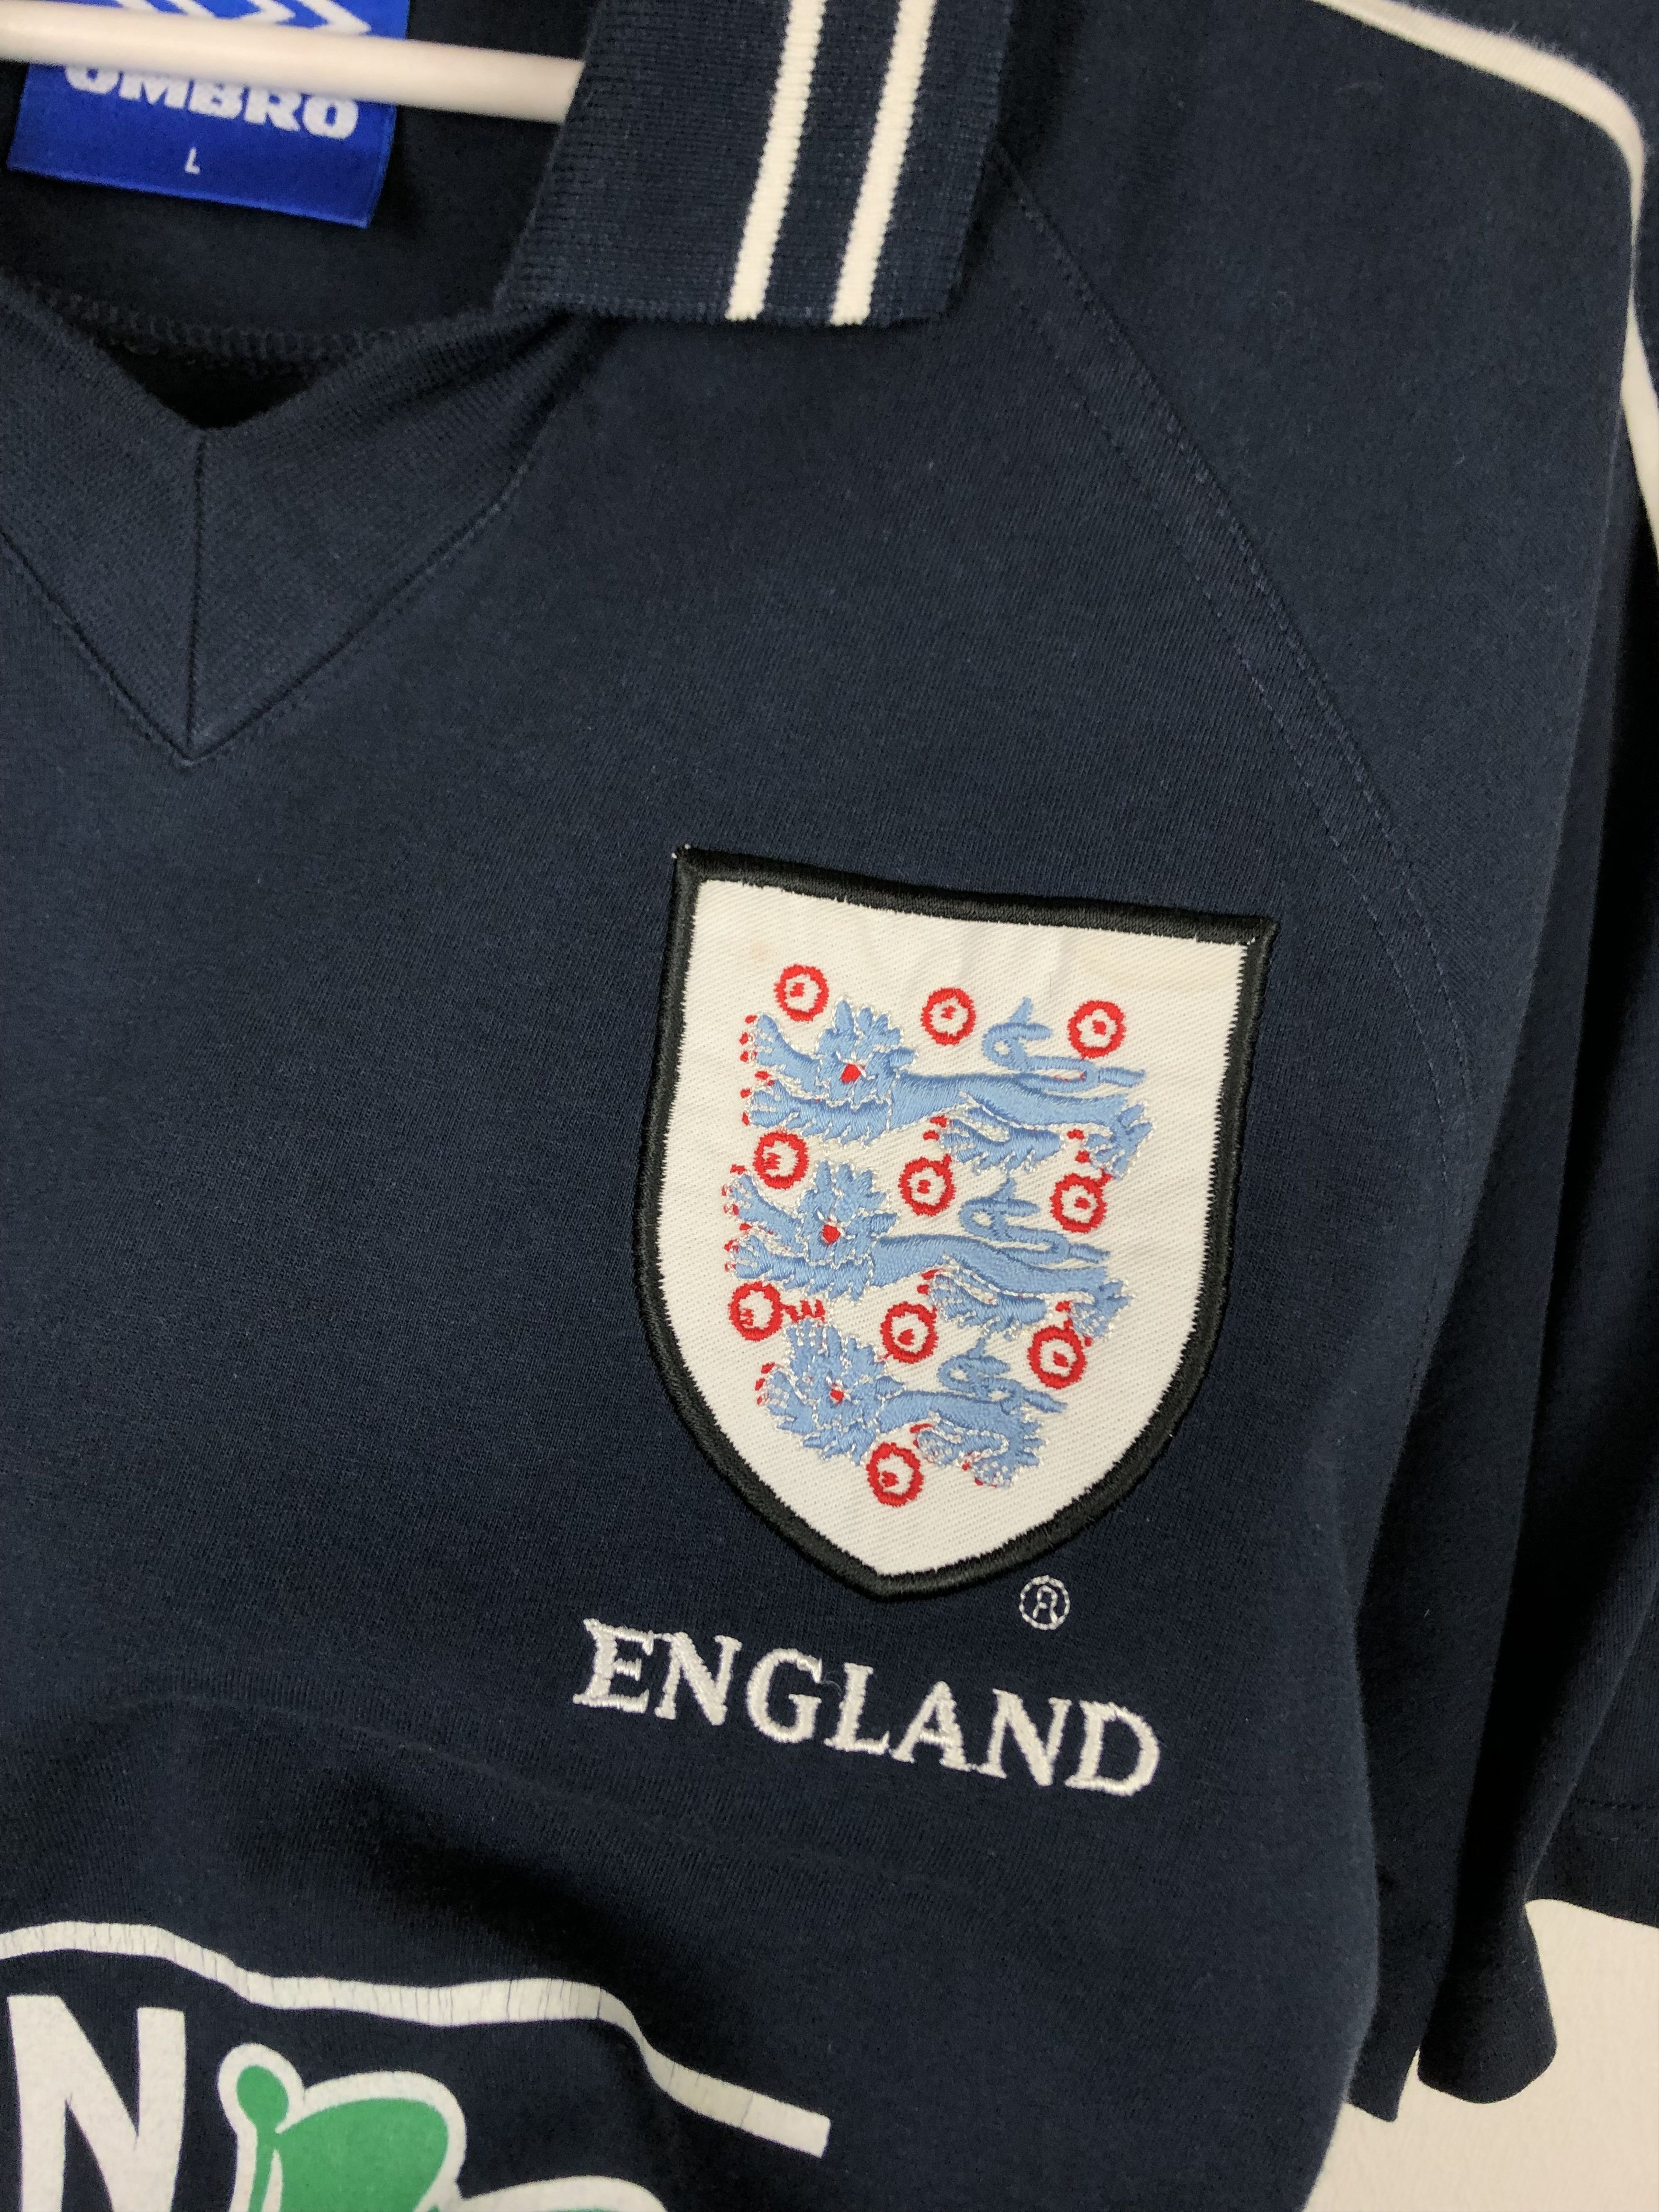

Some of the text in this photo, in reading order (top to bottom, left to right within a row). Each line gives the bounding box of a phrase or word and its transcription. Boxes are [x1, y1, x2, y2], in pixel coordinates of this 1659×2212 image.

[64, 65, 359, 140] UMBRO
[184, 146, 201, 175] L
[572, 1618, 1161, 1797] ENGLAND
